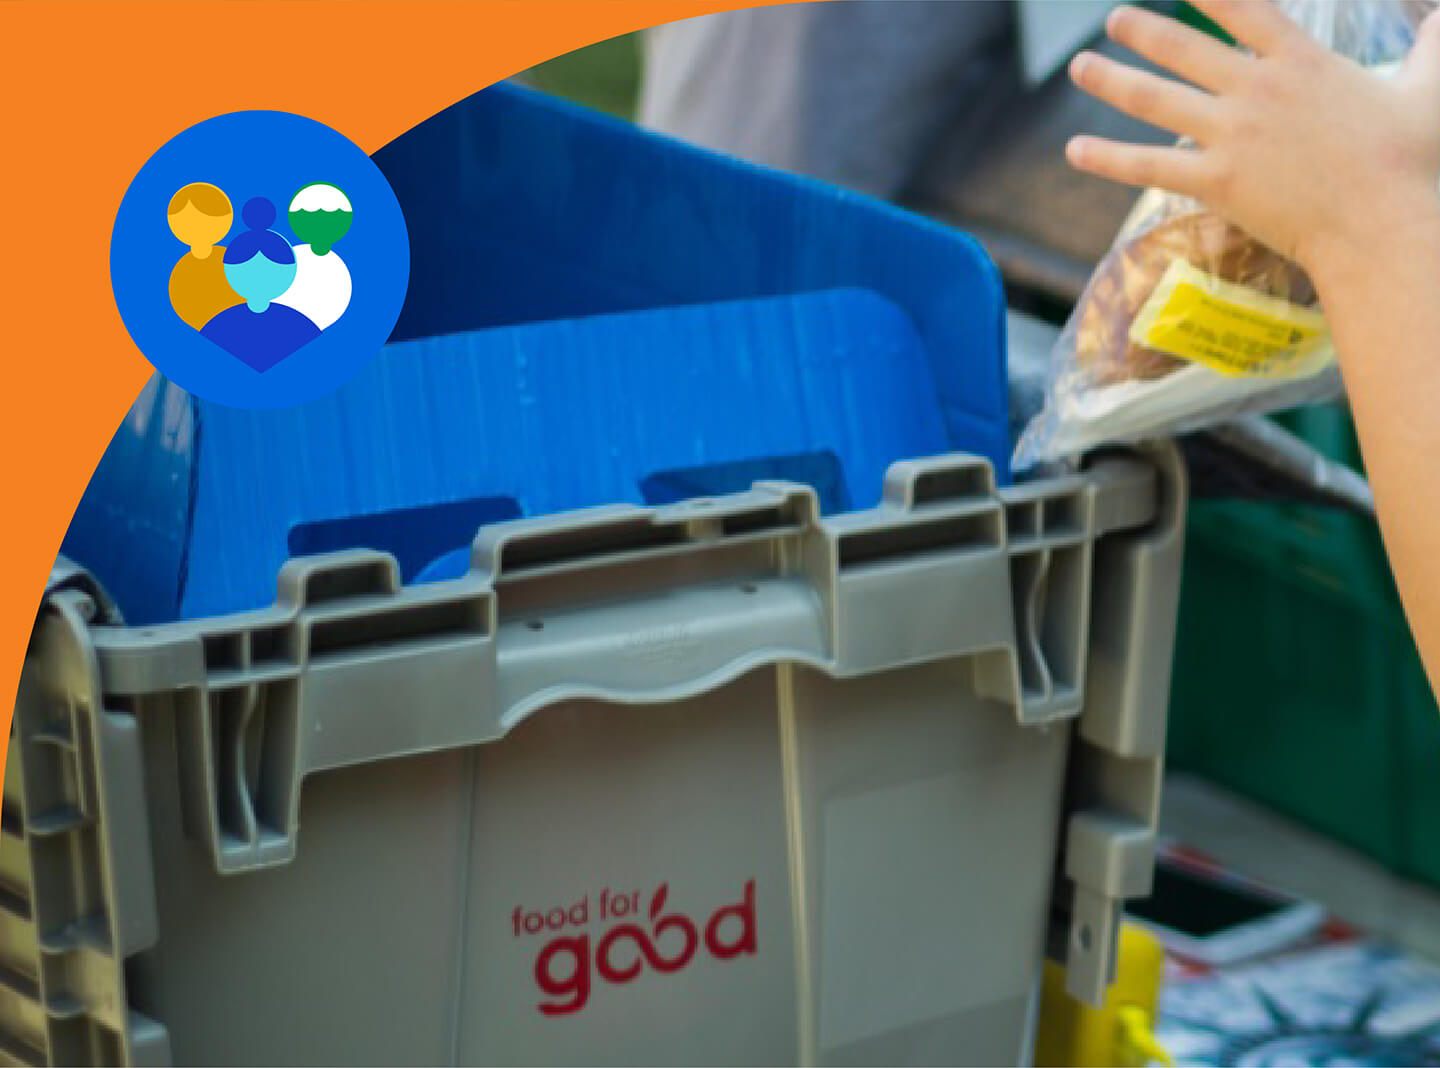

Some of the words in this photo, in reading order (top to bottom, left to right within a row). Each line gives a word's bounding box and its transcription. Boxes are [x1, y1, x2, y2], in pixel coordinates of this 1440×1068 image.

[512, 892, 589, 937] food
[600, 887, 639, 920] for
[535, 878, 757, 1016] good
